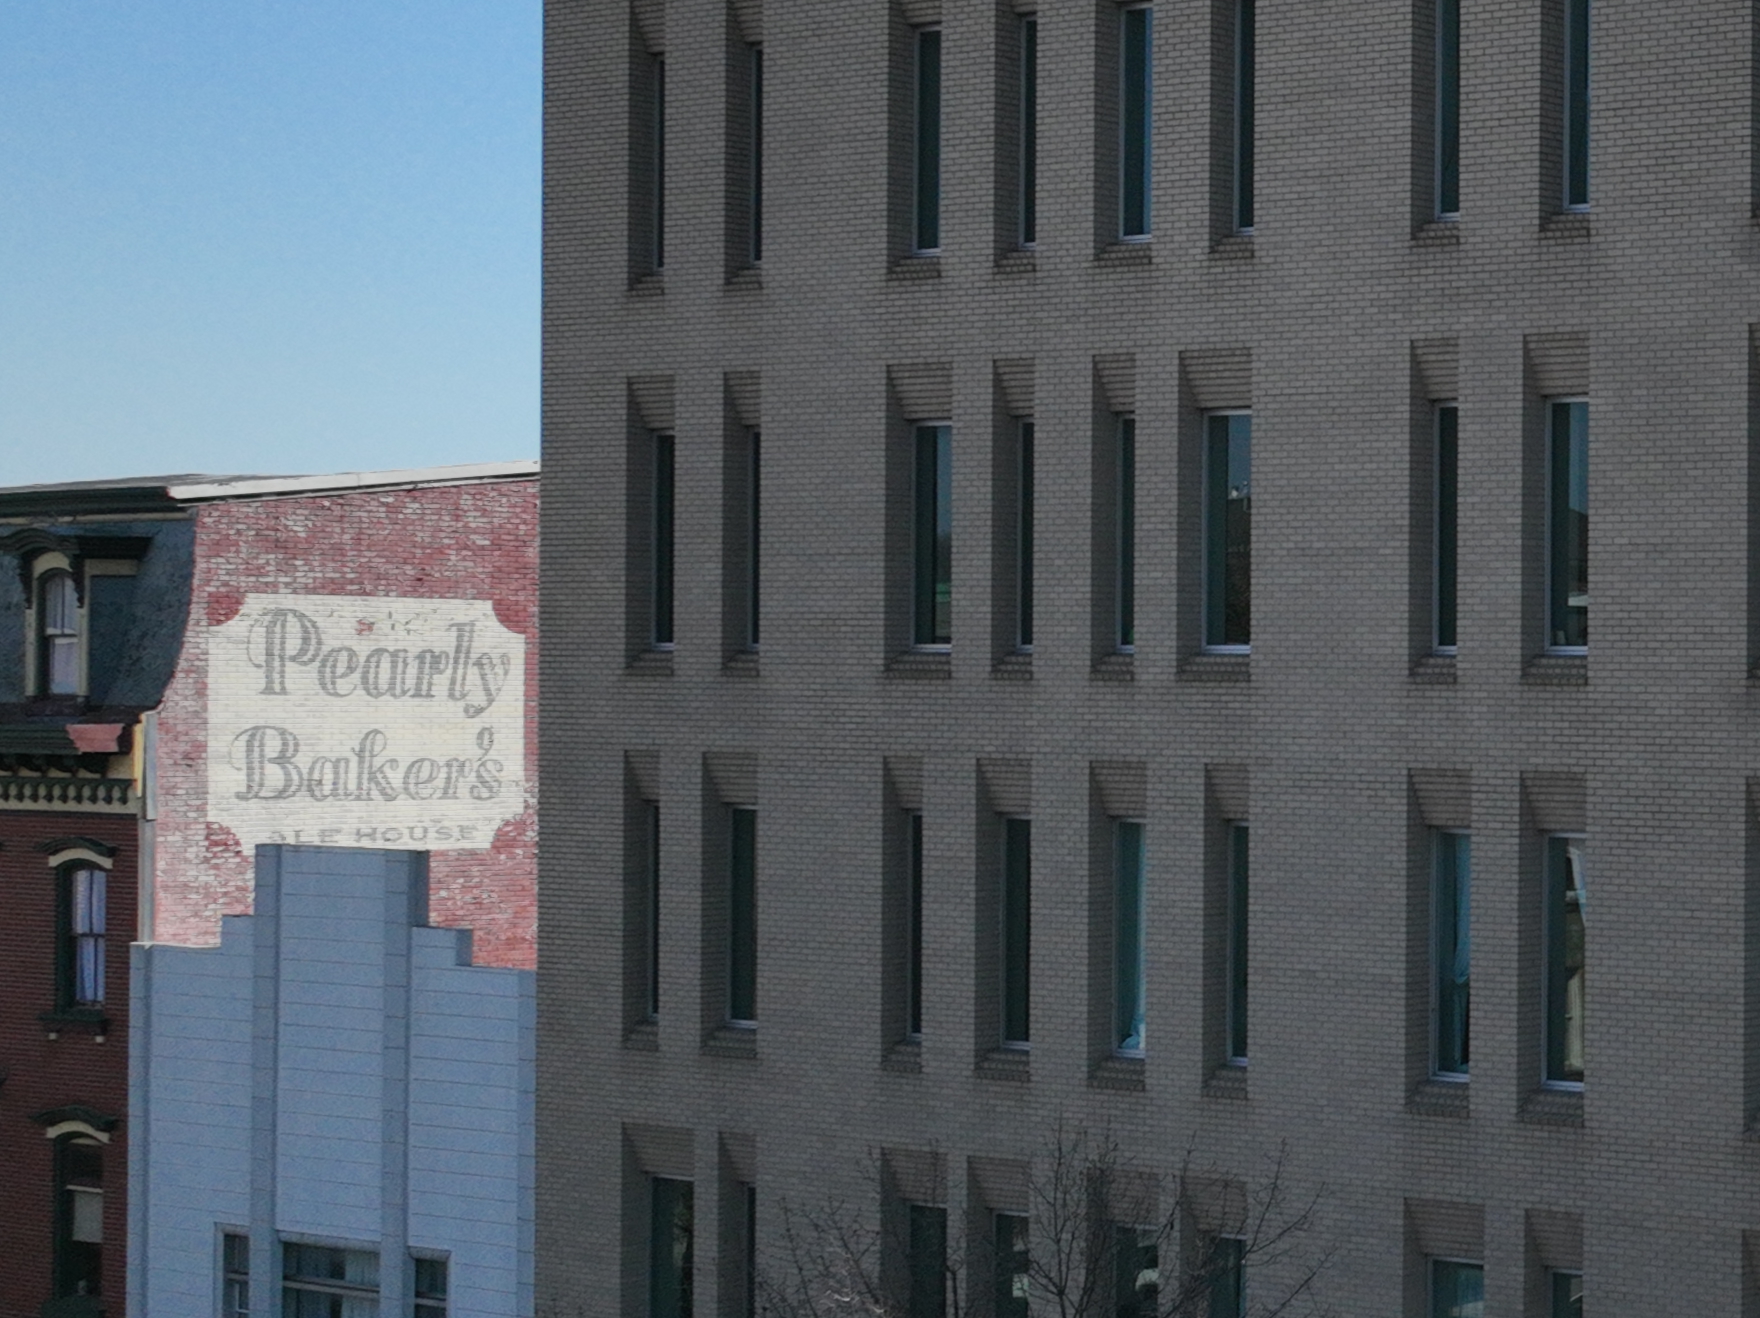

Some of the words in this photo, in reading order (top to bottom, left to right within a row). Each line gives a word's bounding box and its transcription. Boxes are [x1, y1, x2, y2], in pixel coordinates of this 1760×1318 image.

[247, 608, 510, 718] Pearly
[228, 725, 503, 802] Baker's
[355, 824, 478, 842] HOUSE
